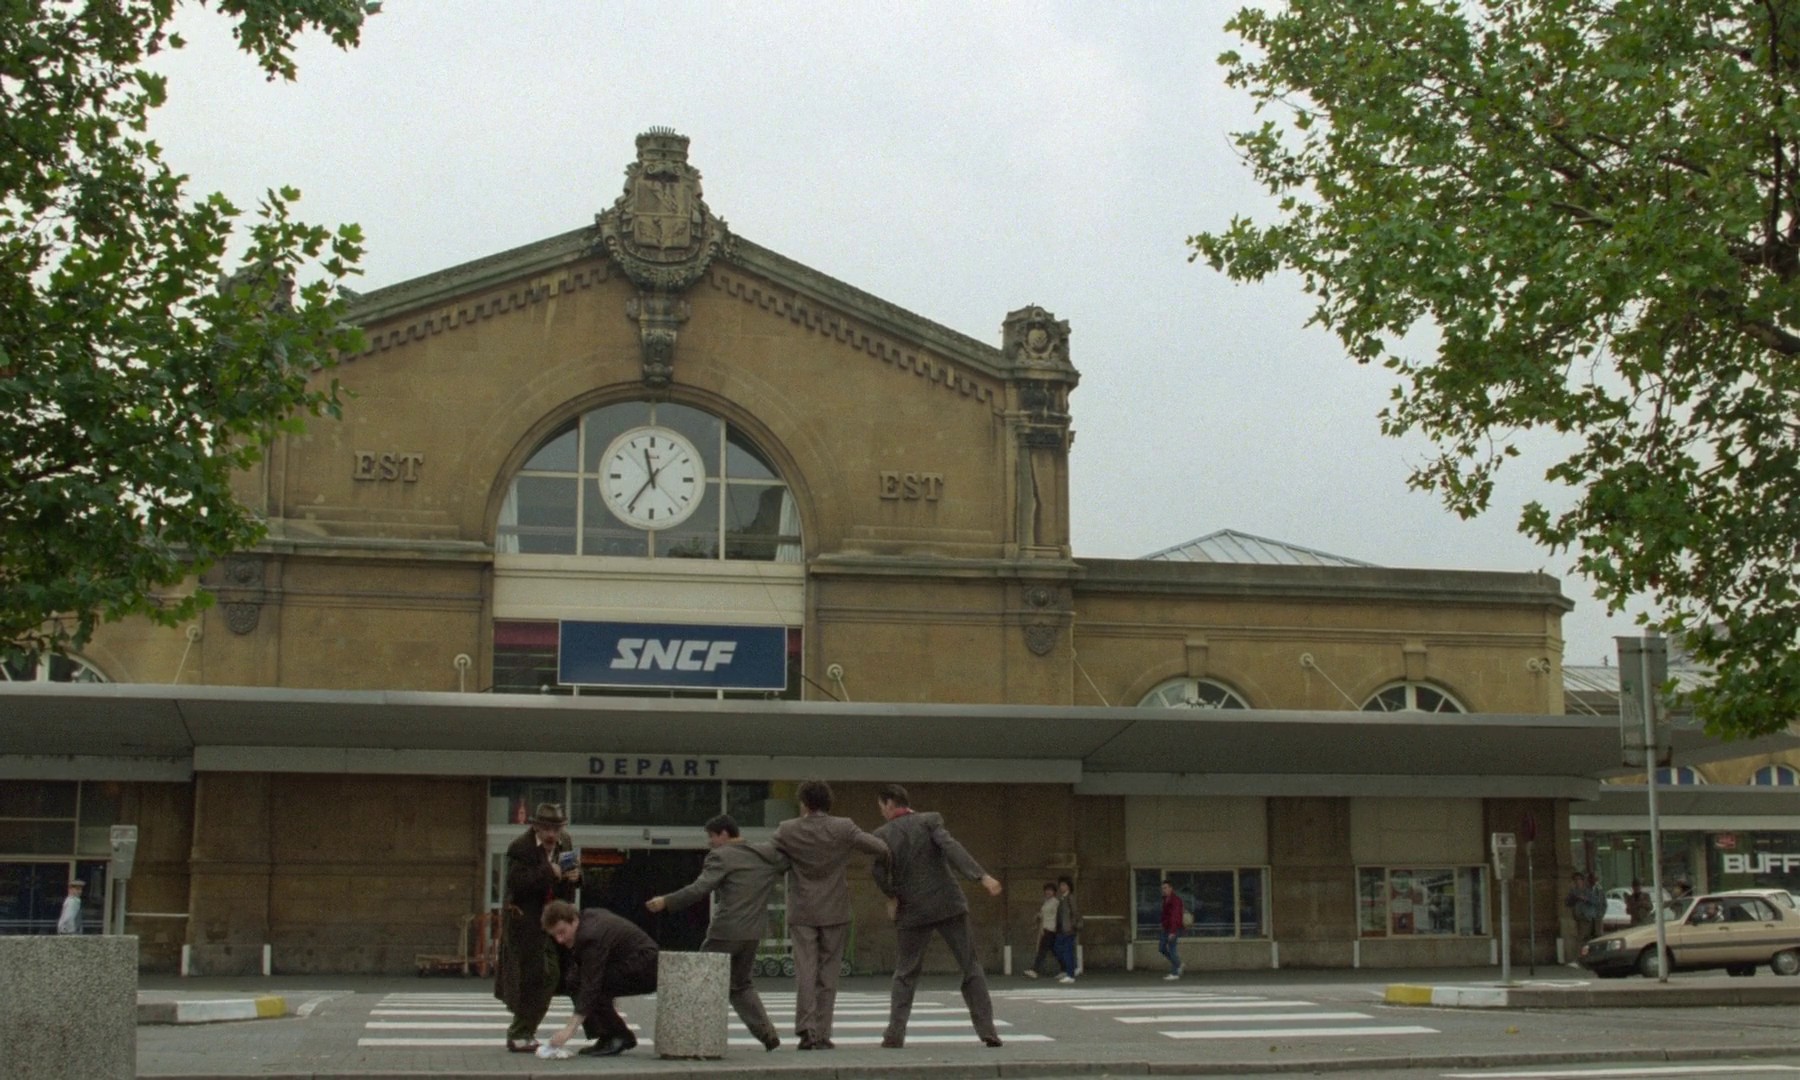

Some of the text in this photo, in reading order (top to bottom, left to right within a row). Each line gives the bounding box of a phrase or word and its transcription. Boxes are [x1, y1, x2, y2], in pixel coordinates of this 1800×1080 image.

[354, 450, 423, 482] EST
[880, 471, 943, 501] EST
[610, 638, 737, 671] SNCF
[588, 757, 720, 776] DEPART
